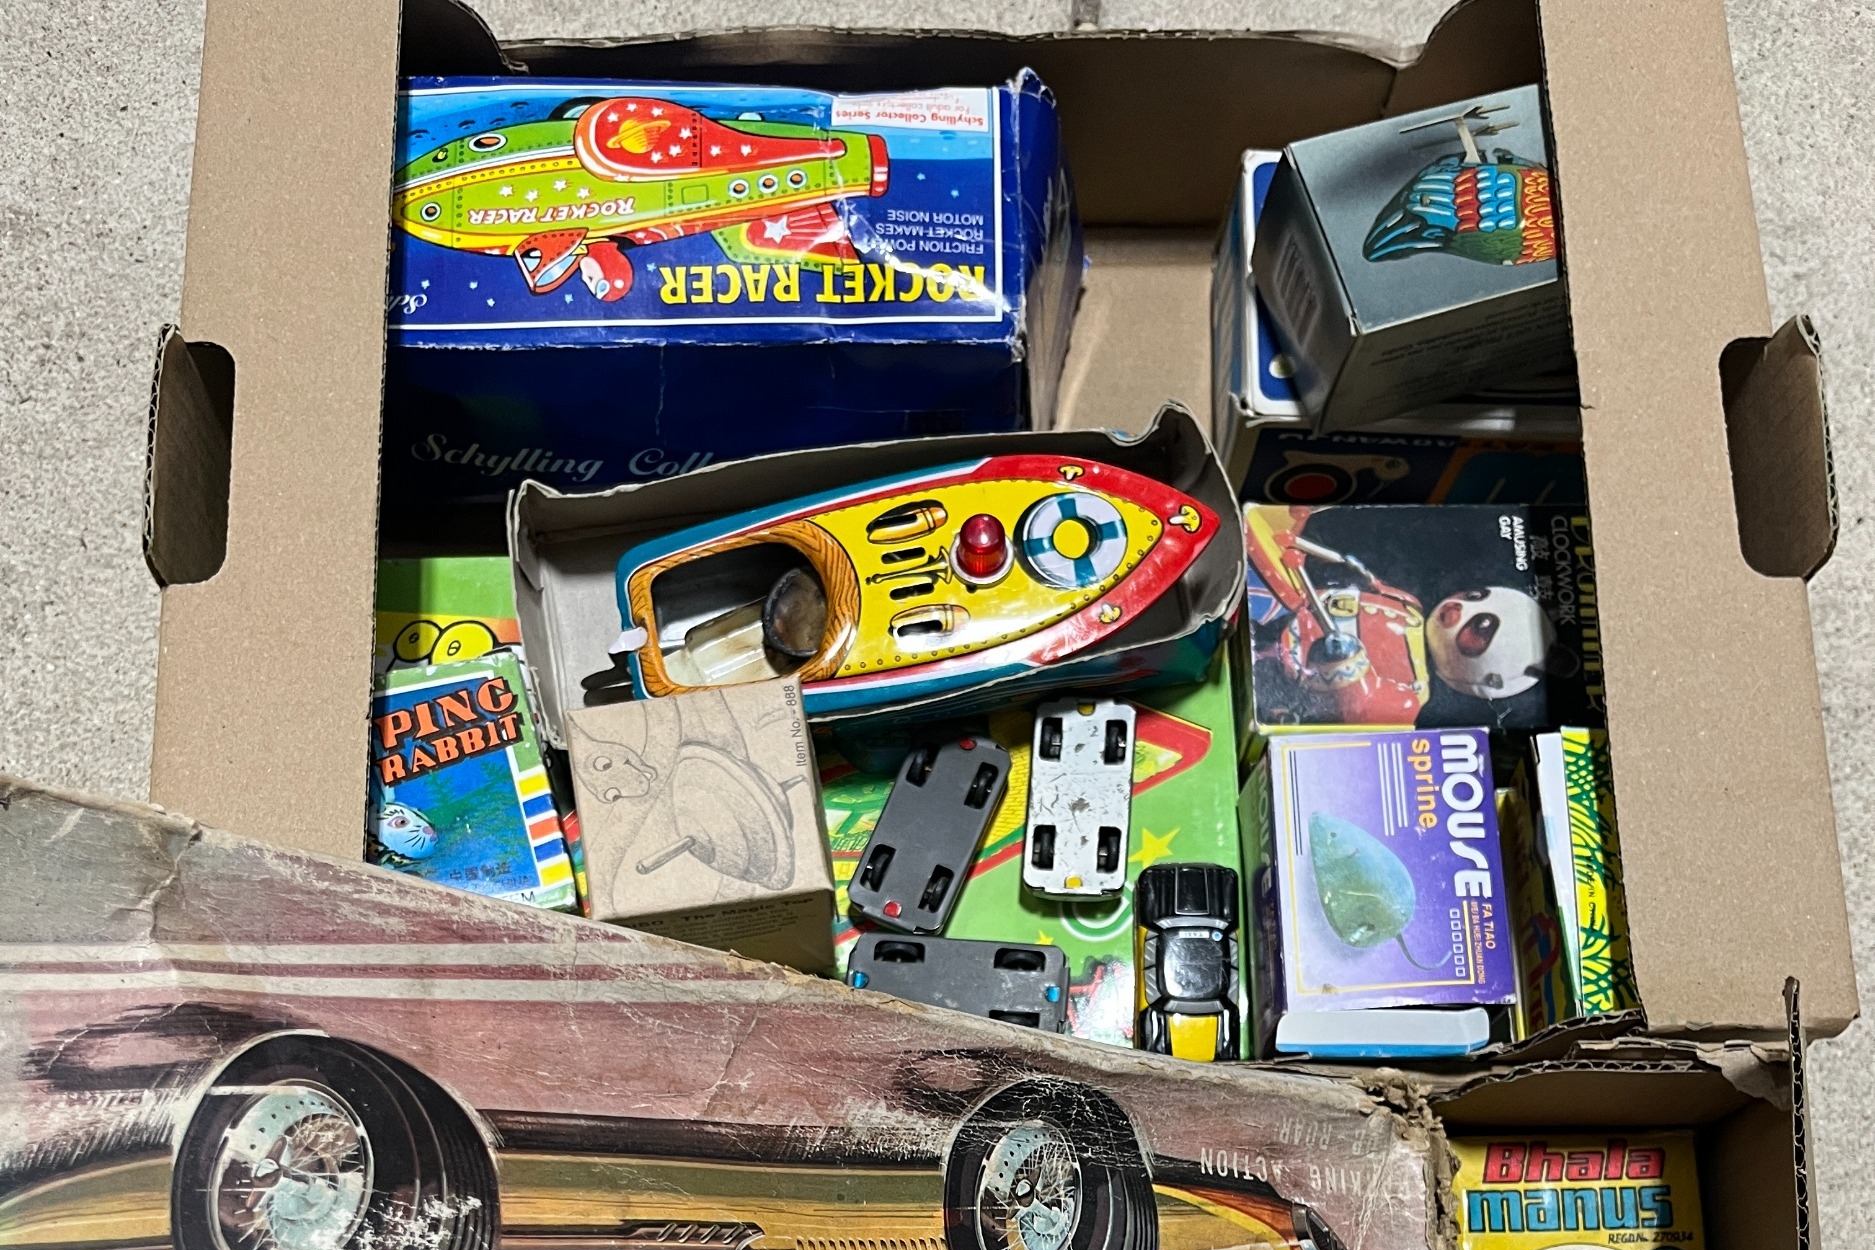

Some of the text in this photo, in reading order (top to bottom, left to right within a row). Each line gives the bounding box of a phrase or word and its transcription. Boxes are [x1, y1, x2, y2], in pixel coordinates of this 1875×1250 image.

[835, 111, 983, 126] Schylling Collector Series
[467, 196, 636, 226] ROCKET RACER
[886, 209, 984, 226] MOTOR NOISE
[876, 222, 984, 241] ROCKET MAKES
[919, 240, 984, 255] FRICTION
[658, 262, 987, 305] ROCKET RACER
[411, 433, 604, 482] Schylling
[1498, 515, 1512, 540] GAY
[1511, 515, 1528, 571] AMUSING
[1550, 515, 1576, 626] CLOCKWORK
[374, 675, 518, 752] PING
[784, 685, 796, 706] 888
[790, 718, 802, 737] No.
[378, 712, 521, 787] RABBIT
[795, 742, 807, 766] Item
[1407, 739, 1439, 829] sprine
[1482, 903, 1495, 949] FA TIAO
[1200, 1147, 1283, 1183] ACTION
[1484, 1140, 1665, 1183] Bhala
[1467, 1184, 1673, 1234] manus
